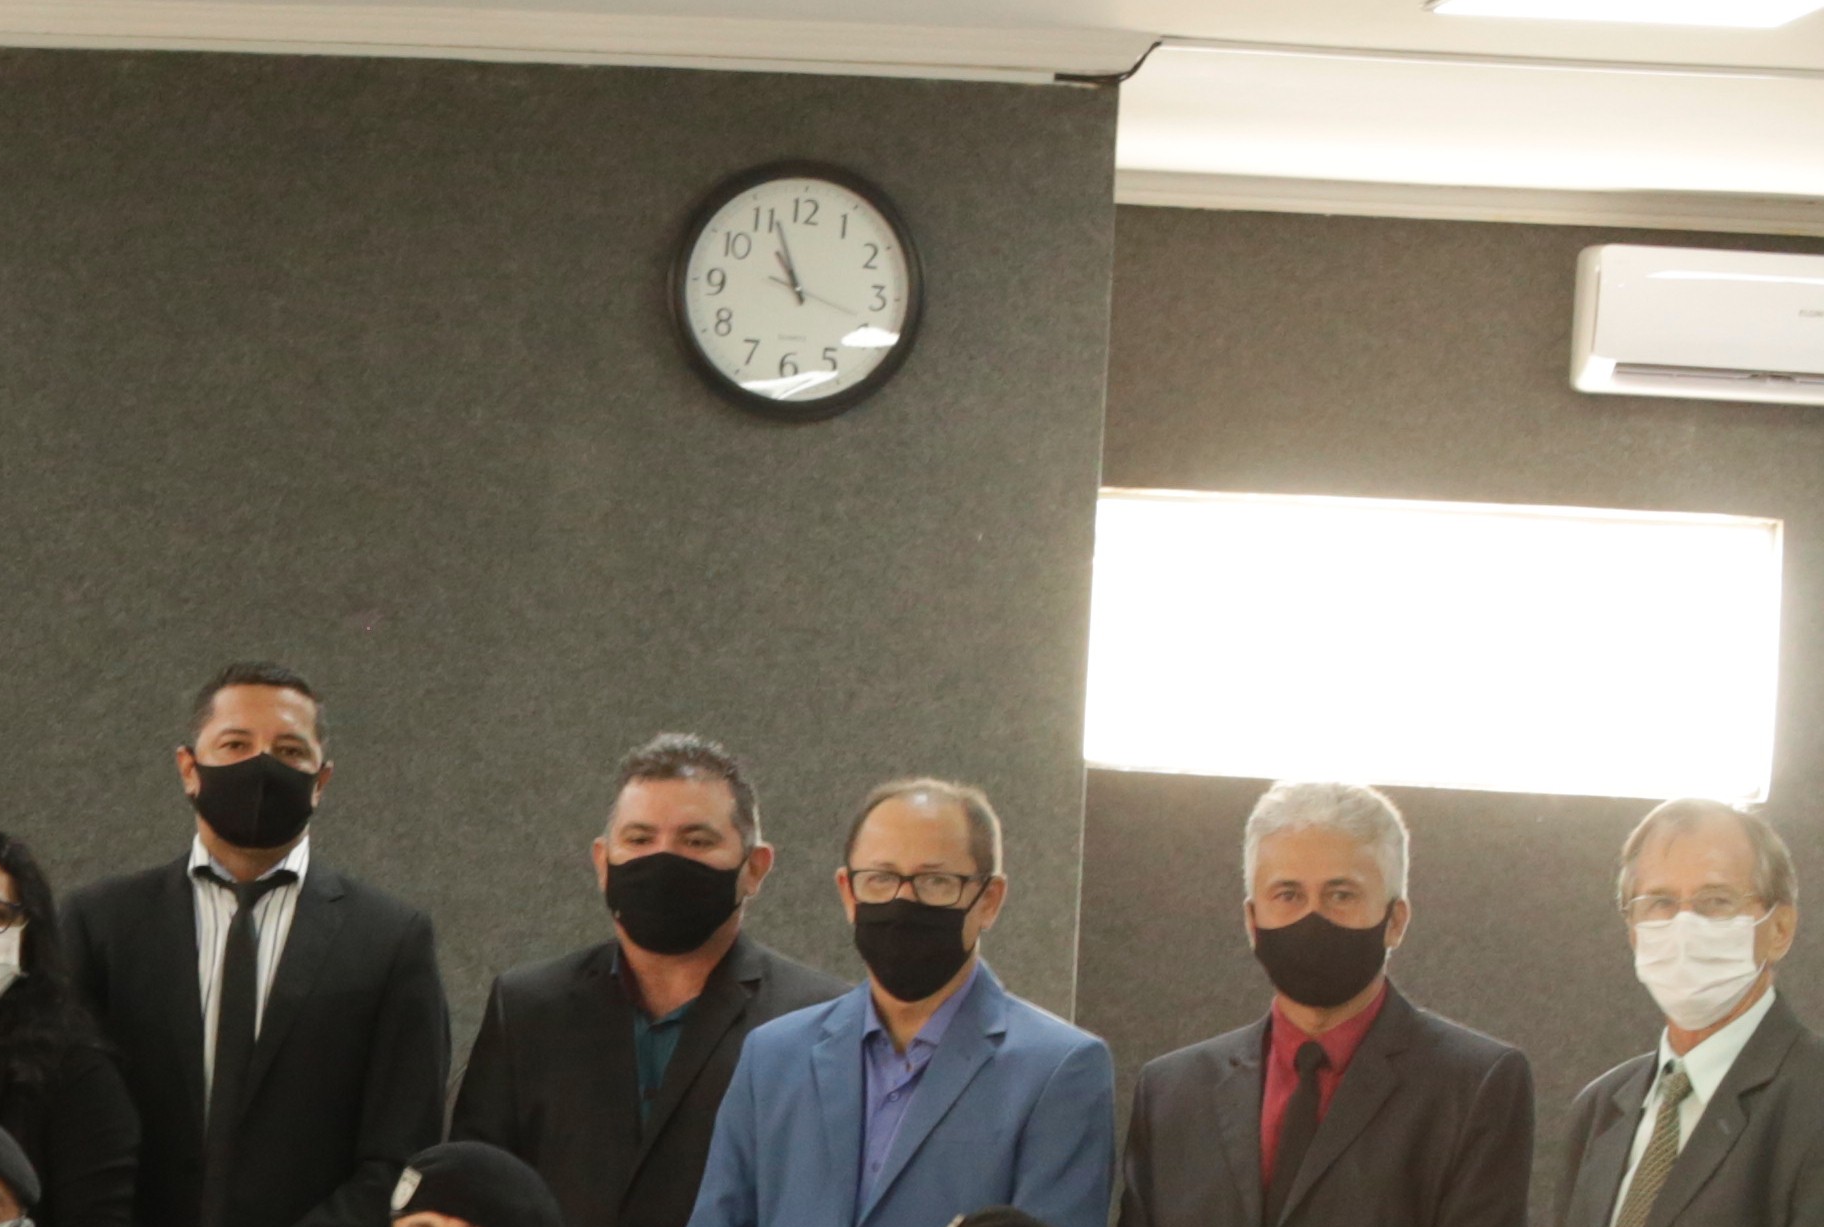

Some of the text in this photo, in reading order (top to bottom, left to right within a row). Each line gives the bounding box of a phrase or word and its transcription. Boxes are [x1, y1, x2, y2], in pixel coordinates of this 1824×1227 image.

[753, 206, 776, 233] 11
[792, 197, 819, 226] 12
[840, 213, 849, 239] 1
[724, 231, 752, 260] 10
[862, 242, 879, 270] 2
[705, 267, 727, 296] 9
[868, 284, 887, 312] 3
[714, 307, 733, 337] 8
[742, 338, 760, 366] 7
[779, 352, 799, 378] 6
[821, 347, 839, 372] 5
